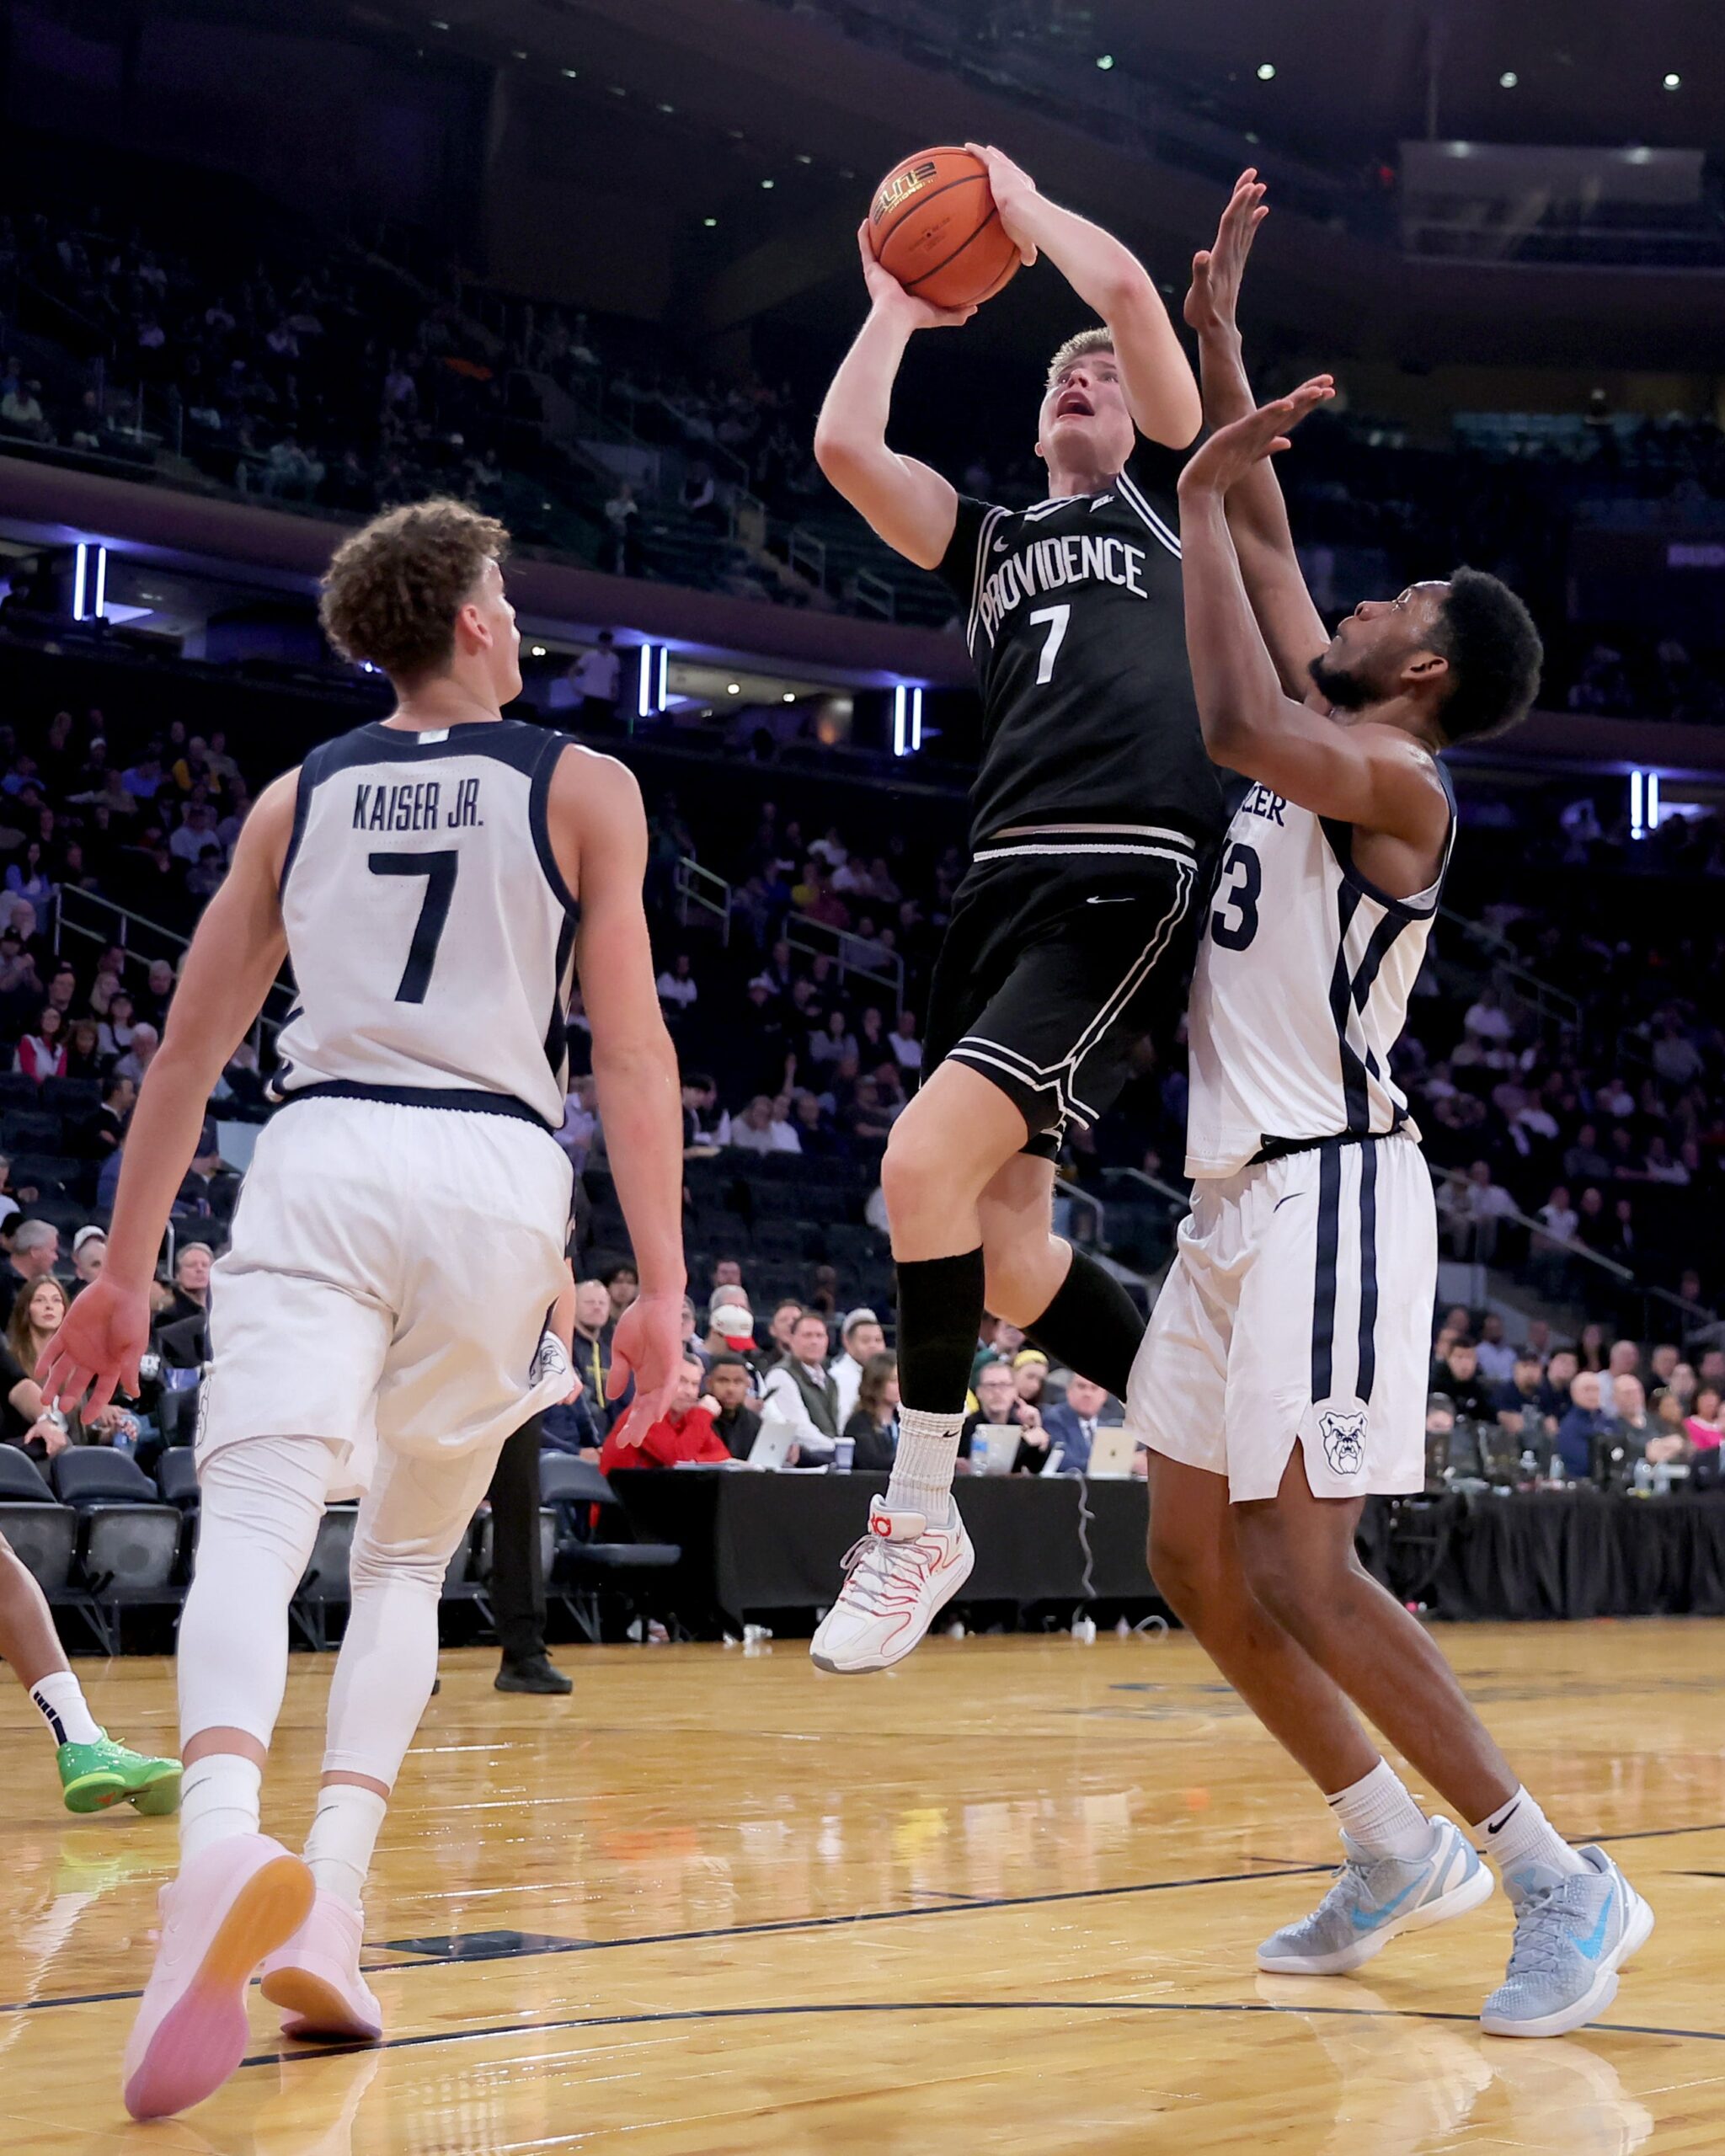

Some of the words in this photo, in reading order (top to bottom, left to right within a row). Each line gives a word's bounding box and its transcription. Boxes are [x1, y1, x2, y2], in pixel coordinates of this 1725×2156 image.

[979, 535, 1148, 649] PROVIDENCE
[1029, 604, 1071, 686] 7
[352, 782, 441, 831] KAISER
[447, 778, 484, 828] JR.
[1241, 784, 1287, 827] LER
[367, 850, 459, 1006] 7
